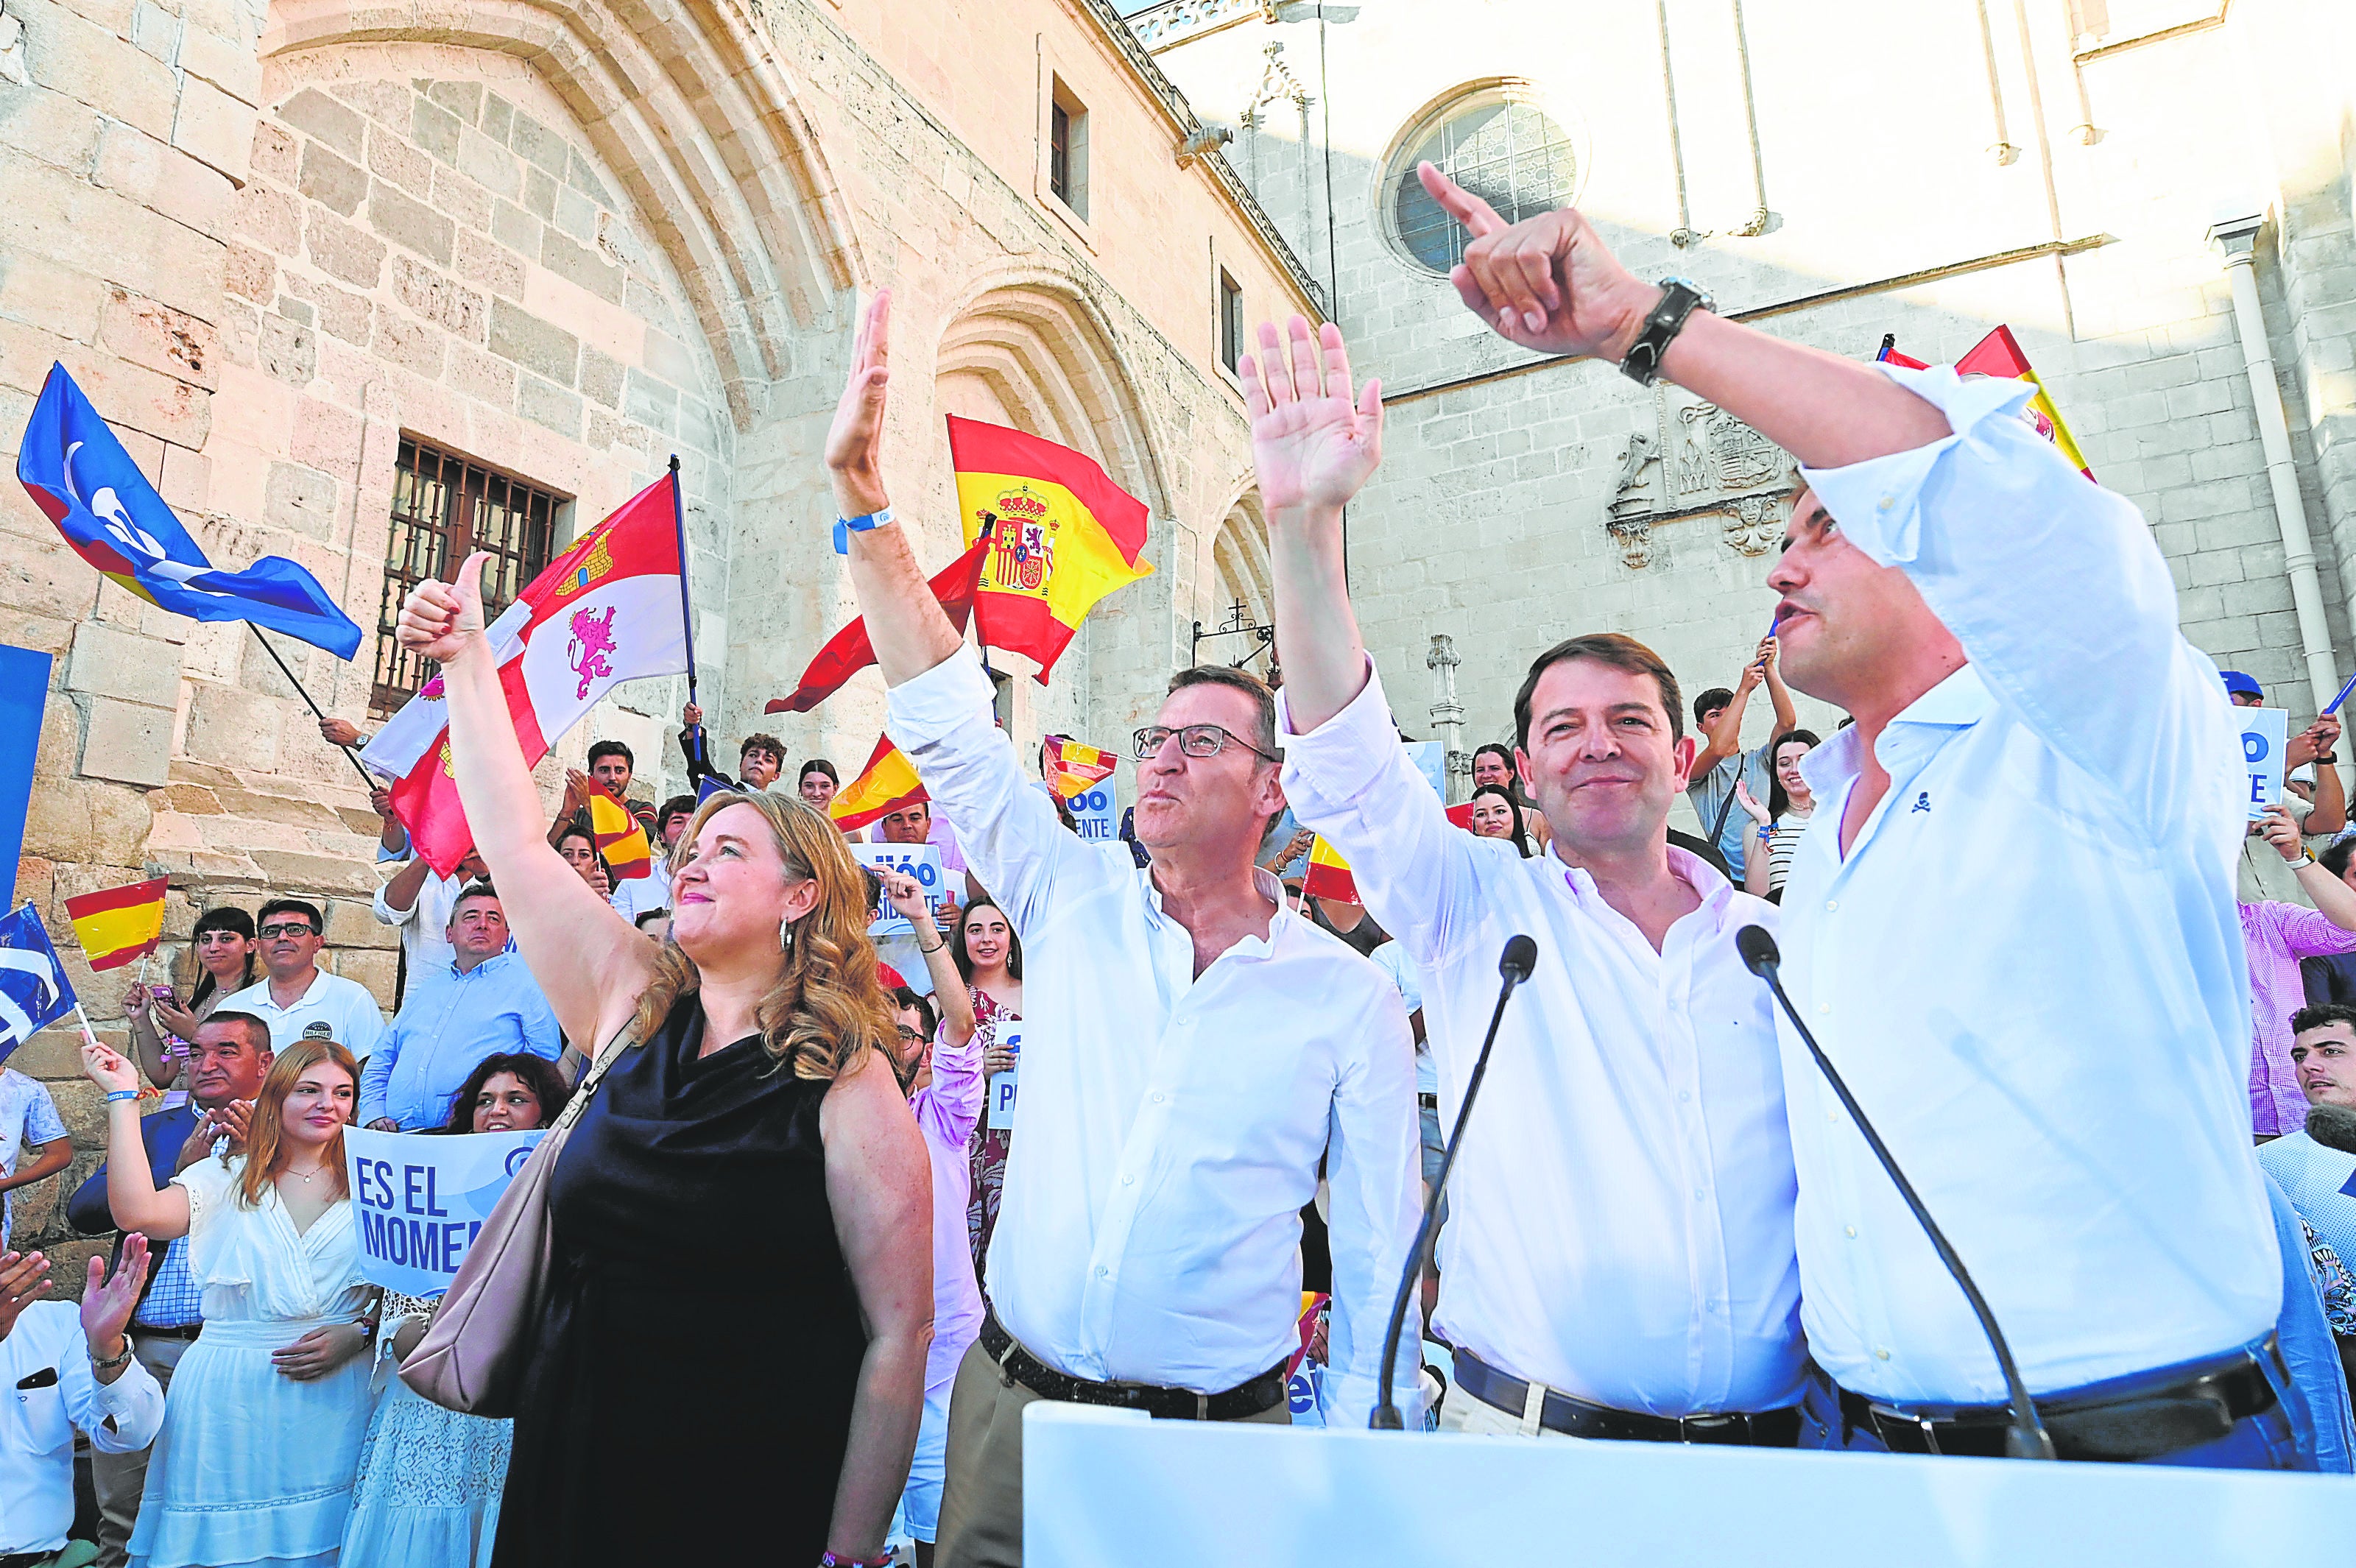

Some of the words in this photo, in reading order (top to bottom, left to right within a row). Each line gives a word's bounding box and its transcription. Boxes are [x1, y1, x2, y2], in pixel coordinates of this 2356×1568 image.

[2249, 774, 2267, 802] E
[999, 1084, 1018, 1112] P
[356, 1156, 395, 1210] ES
[404, 1165, 448, 1218] EL
